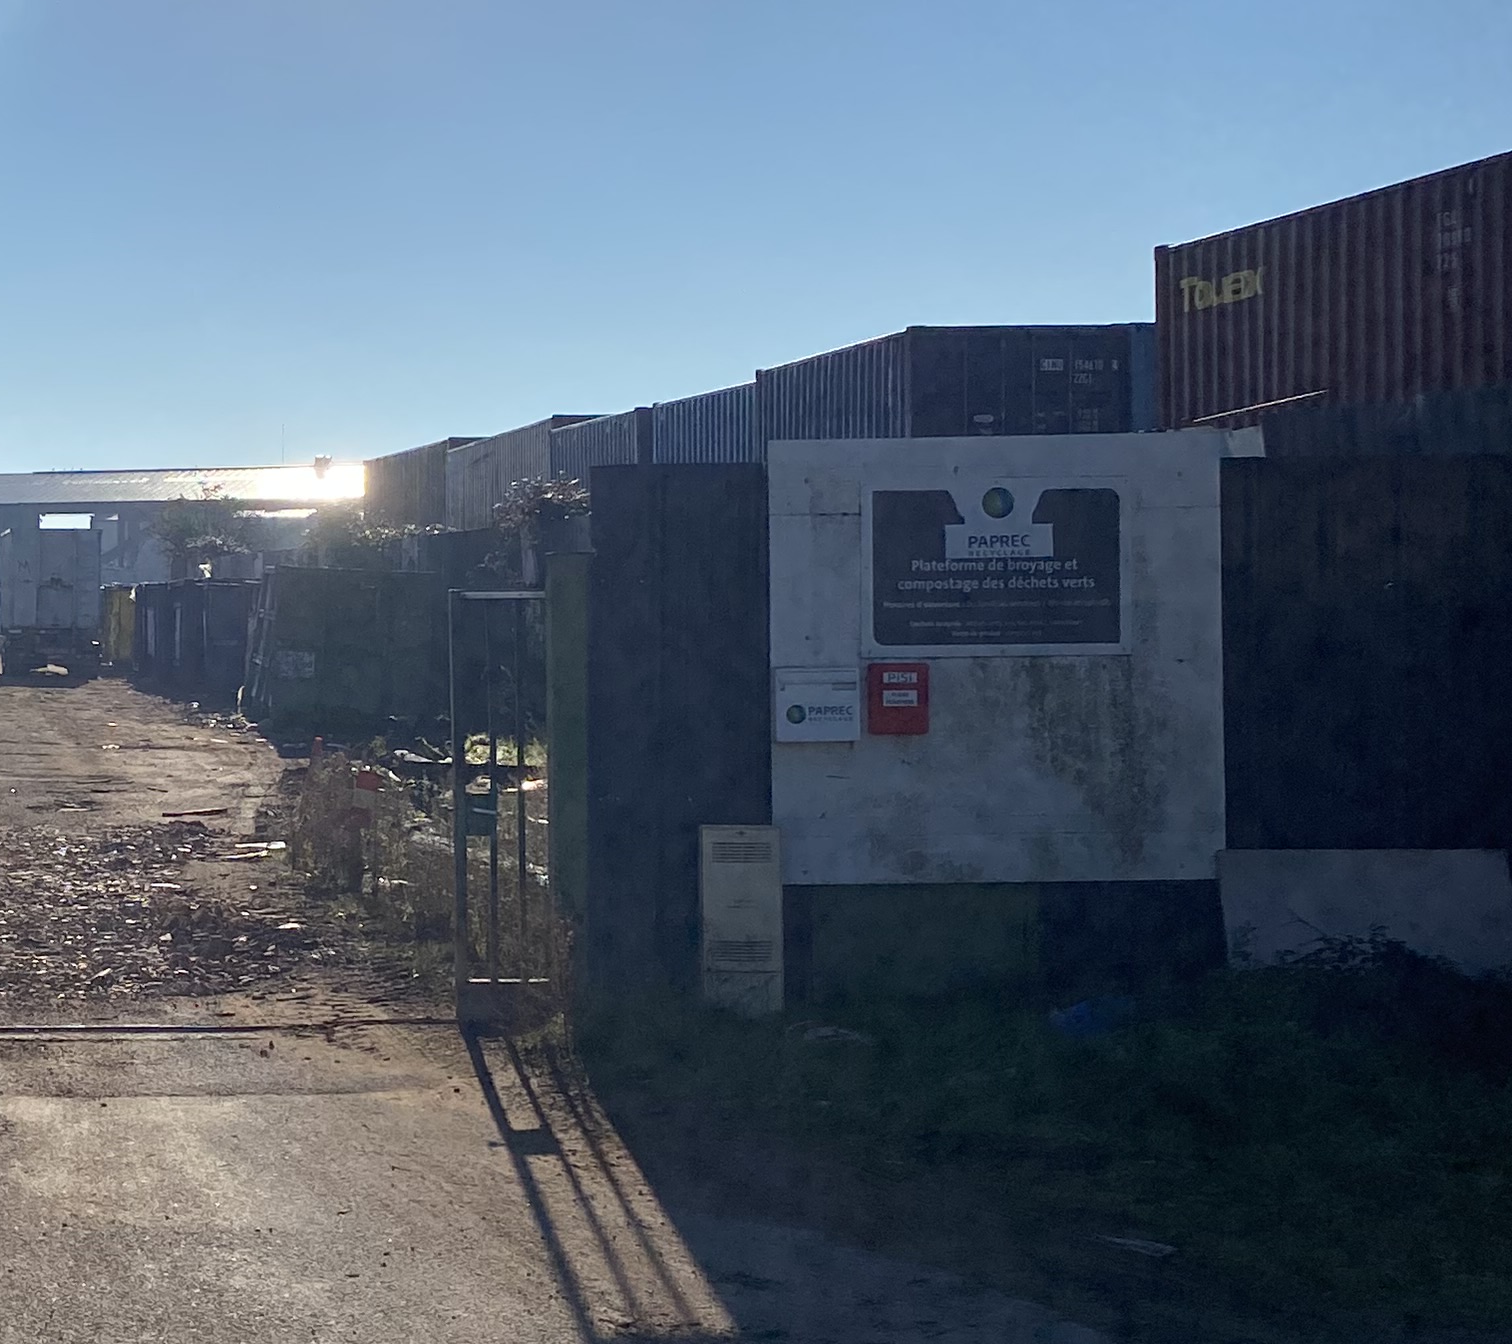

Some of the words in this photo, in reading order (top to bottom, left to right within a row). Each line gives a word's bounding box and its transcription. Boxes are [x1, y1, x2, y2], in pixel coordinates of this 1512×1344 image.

[967, 534, 1031, 548] PAPREC
[911, 560, 985, 572] Plateforme
[988, 560, 1004, 571] de
[1008, 559, 1062, 573] broyage
[1065, 558, 1078, 570] et
[897, 578, 980, 592] compostage
[982, 577, 1005, 589] des
[1008, 576, 1059, 588] déchets
[1062, 576, 1096, 588] verts
[807, 705, 854, 716] PAPREC
